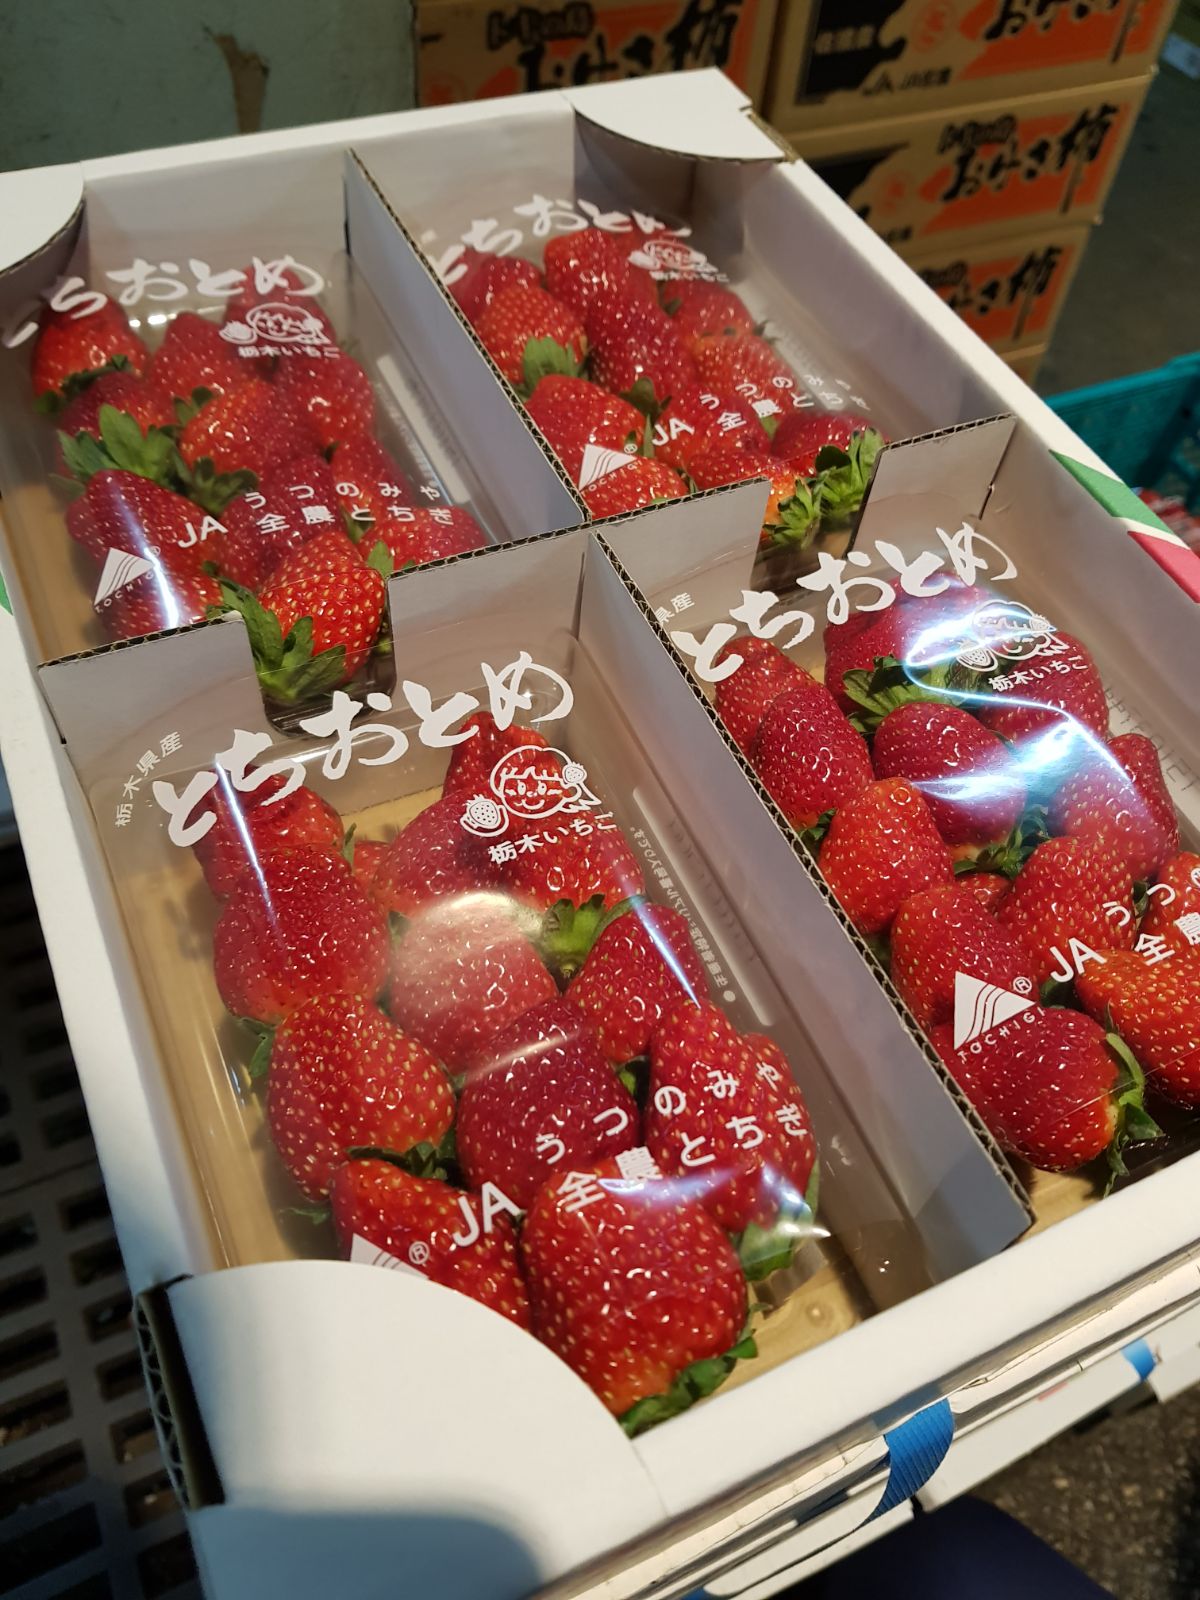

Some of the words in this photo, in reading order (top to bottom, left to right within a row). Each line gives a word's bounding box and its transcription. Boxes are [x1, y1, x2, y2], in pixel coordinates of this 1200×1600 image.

[651, 416, 696, 447] JA
[245, 482, 441, 510] うつのみや
[177, 515, 229, 549] JA
[95, 569, 158, 614] TOCHIG
[670, 521, 1018, 683] とちおとめ
[988, 653, 1089, 693] 栃木いちご
[152, 650, 574, 848] とちおとめ
[114, 731, 184, 828] 栃木県産
[487, 811, 618, 865] 栃木いちご
[1049, 937, 1108, 983] JA
[956, 1005, 1046, 1064] TOCHIGI
[535, 1061, 781, 1165] うつのみや
[452, 1180, 522, 1248] JA
